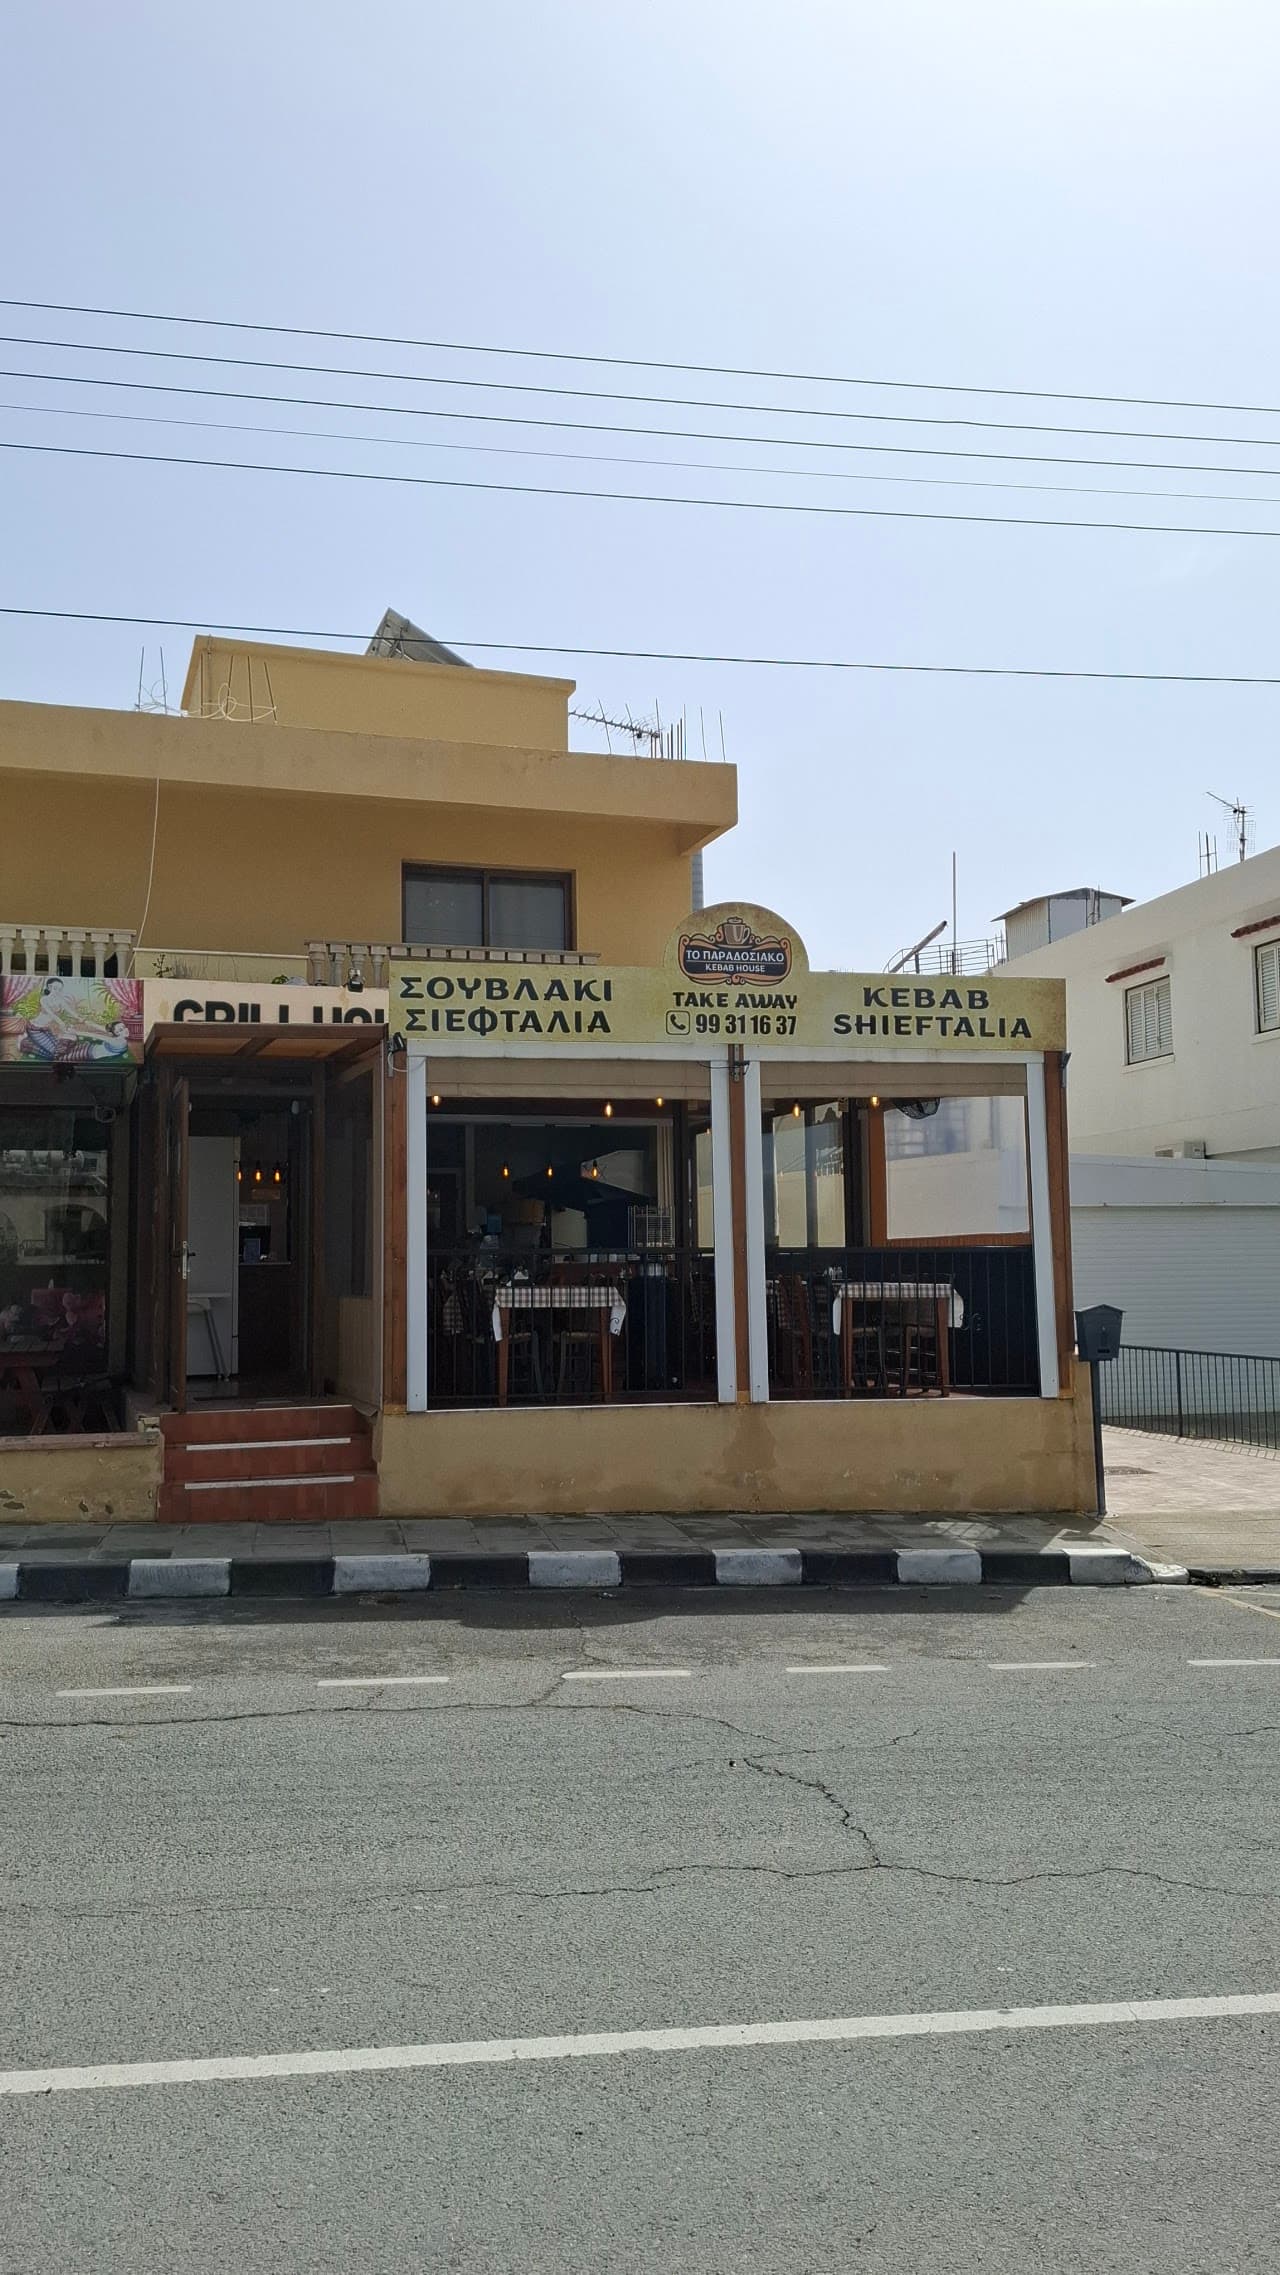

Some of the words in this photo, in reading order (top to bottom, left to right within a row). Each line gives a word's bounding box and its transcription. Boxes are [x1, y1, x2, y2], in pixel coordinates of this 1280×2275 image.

[686, 950, 700, 960] ΤΟ
[703, 950, 785, 962] ΠΑΡΑΔΟΣΙΑΚΟ
[705, 963, 734, 972] KEBAB
[736, 964, 766, 973] HOUSE
[400, 976, 612, 1002] ΣΟΥΒΛΑΚΙ
[862, 987, 990, 1010] KEBAB
[672, 991, 729, 1008] TAKE
[735, 993, 798, 1010] AWAY
[405, 1005, 611, 1036] ΣΙΕΦΤΑΛΙΑ
[695, 1013, 721, 1034] 99
[725, 1013, 746, 1034] 31
[750, 1014, 771, 1035] 16
[776, 1014, 797, 1035] 37
[833, 1013, 1032, 1039] SHIEFTALIA
